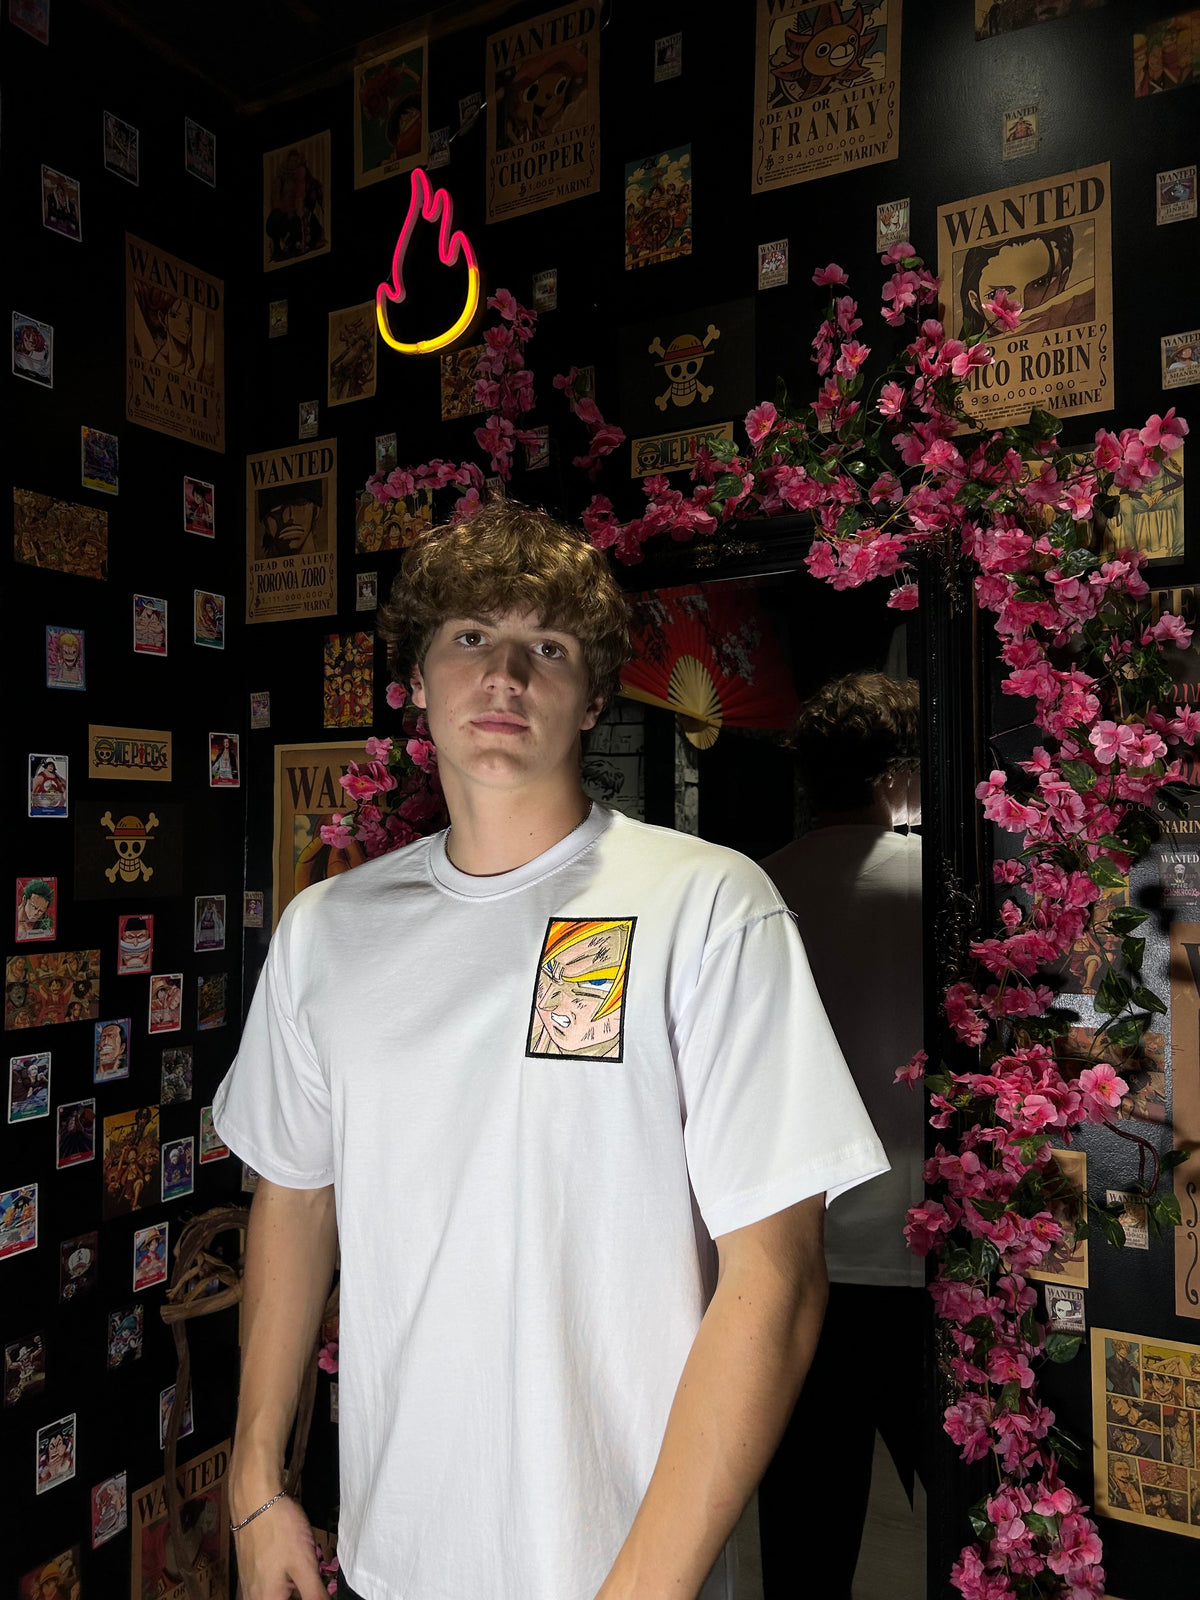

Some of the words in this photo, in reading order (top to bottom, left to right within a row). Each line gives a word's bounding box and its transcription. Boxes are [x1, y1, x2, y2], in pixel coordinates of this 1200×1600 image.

[493, 8, 595, 67] WANTED
[766, 106, 802, 125] DEAD
[812, 98, 830, 112] OR
[840, 82, 887, 105] ALIVE
[1004, 106, 1038, 120] WANTED
[771, 99, 880, 152] FRANKY
[496, 147, 524, 165] DEAD
[531, 140, 545, 153] OR
[554, 126, 588, 147] ALIVE
[843, 141, 888, 162] MARINE
[499, 142, 584, 187] CHOPPER
[1158, 169, 1196, 183] WANTED
[556, 176, 592, 196] MARINE
[878, 201, 909, 214] WANTED
[942, 177, 1105, 247] WANTED
[760, 241, 788, 254] WANTED
[128, 242, 219, 311] WANTED
[1007, 339, 1029, 353] OR
[1041, 325, 1097, 348] ALIVE
[1020, 343, 1091, 382] ROBIN
[134, 359, 161, 377] DEAD
[167, 373, 180, 385] OR
[187, 380, 214, 399] ALIVE
[142, 375, 208, 419] NAMI
[1047, 388, 1103, 411] MARINE
[190, 427, 216, 445] MARINE
[250, 448, 334, 485] WANTED
[254, 561, 277, 572] DEAD
[283, 559, 294, 568] OR
[301, 554, 328, 566] ALIVE
[257, 570, 299, 593] RORONOA
[301, 566, 326, 588] ZORO
[303, 599, 331, 611] MARINE
[1161, 854, 1200, 863] WANTED
[1047, 1288, 1083, 1301] WANTED
